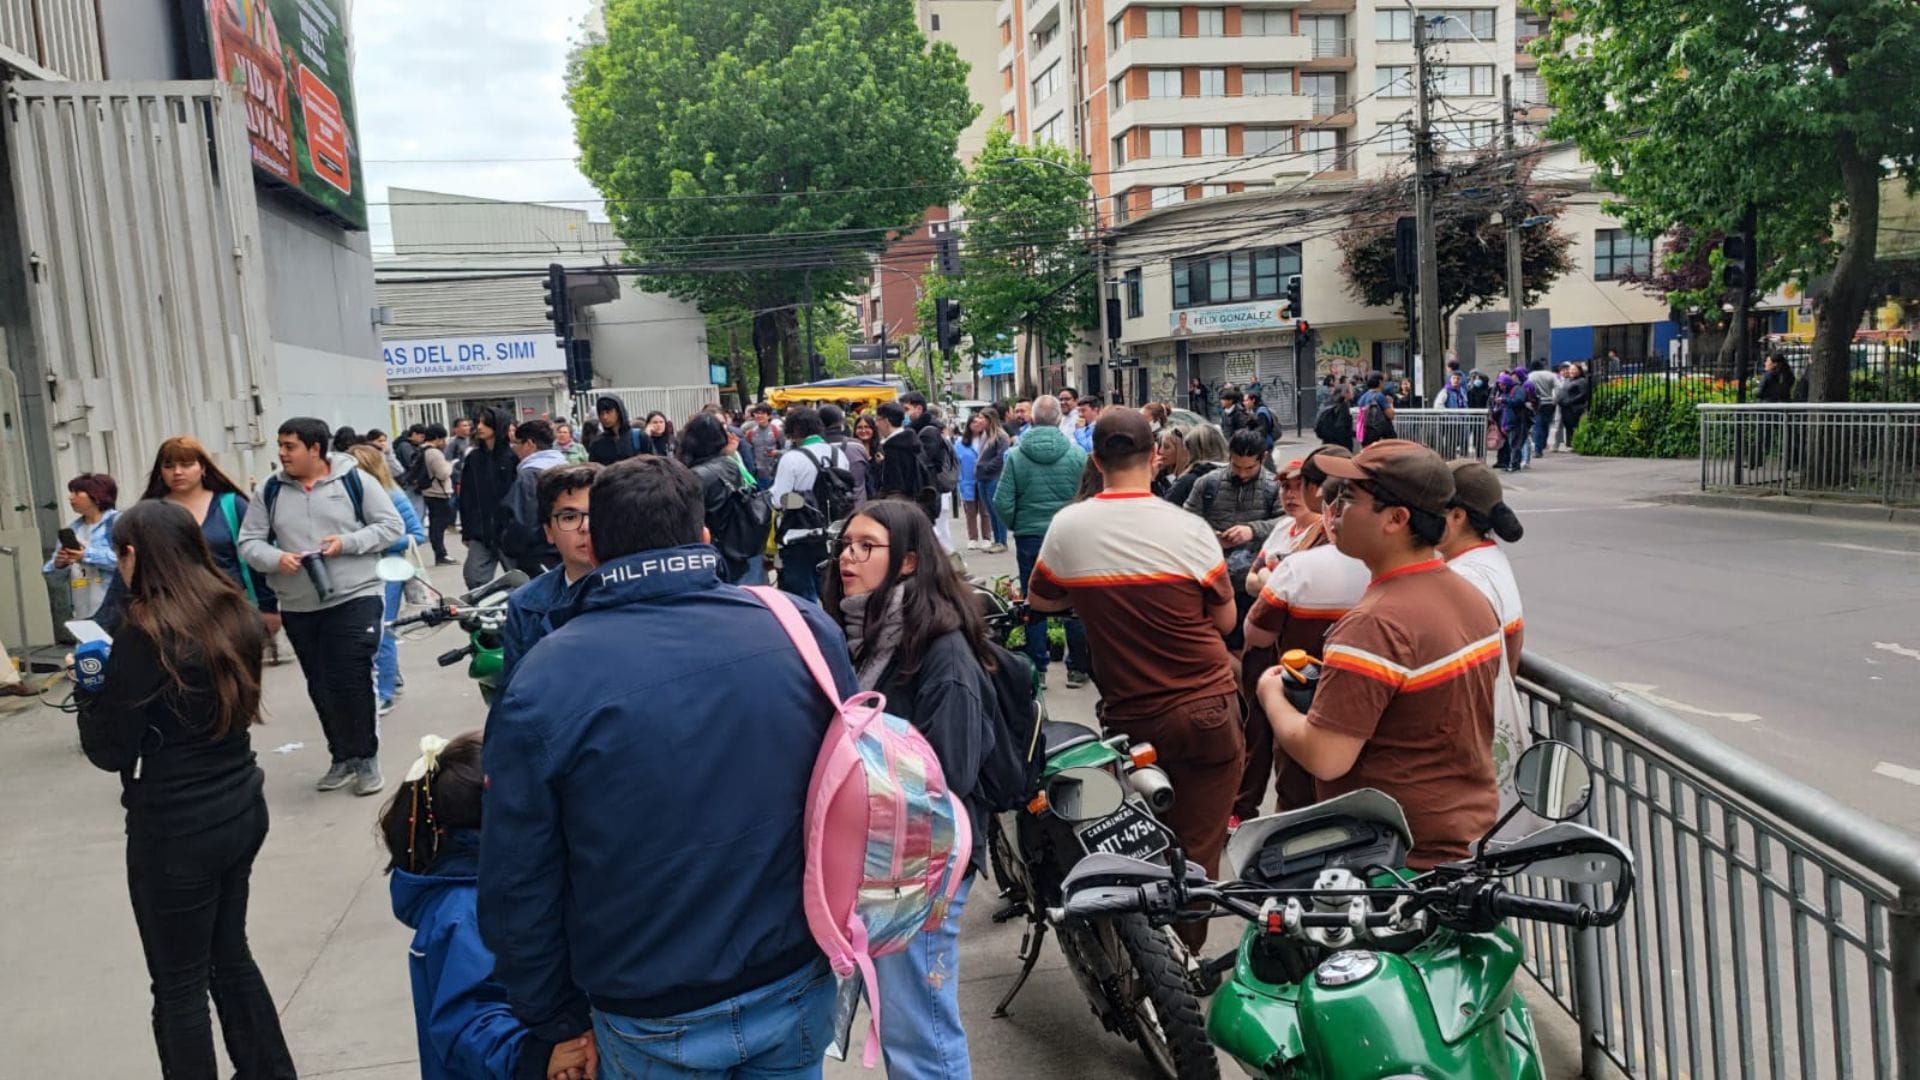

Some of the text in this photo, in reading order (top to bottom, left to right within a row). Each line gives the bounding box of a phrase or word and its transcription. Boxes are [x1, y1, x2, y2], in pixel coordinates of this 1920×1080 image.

[246, 101, 290, 160] LVAJE
[413, 345, 452, 364] DEL
[458, 343, 491, 362] DR.
[496, 341, 535, 360] SIMI
[601, 554, 717, 586] HILFIGER
